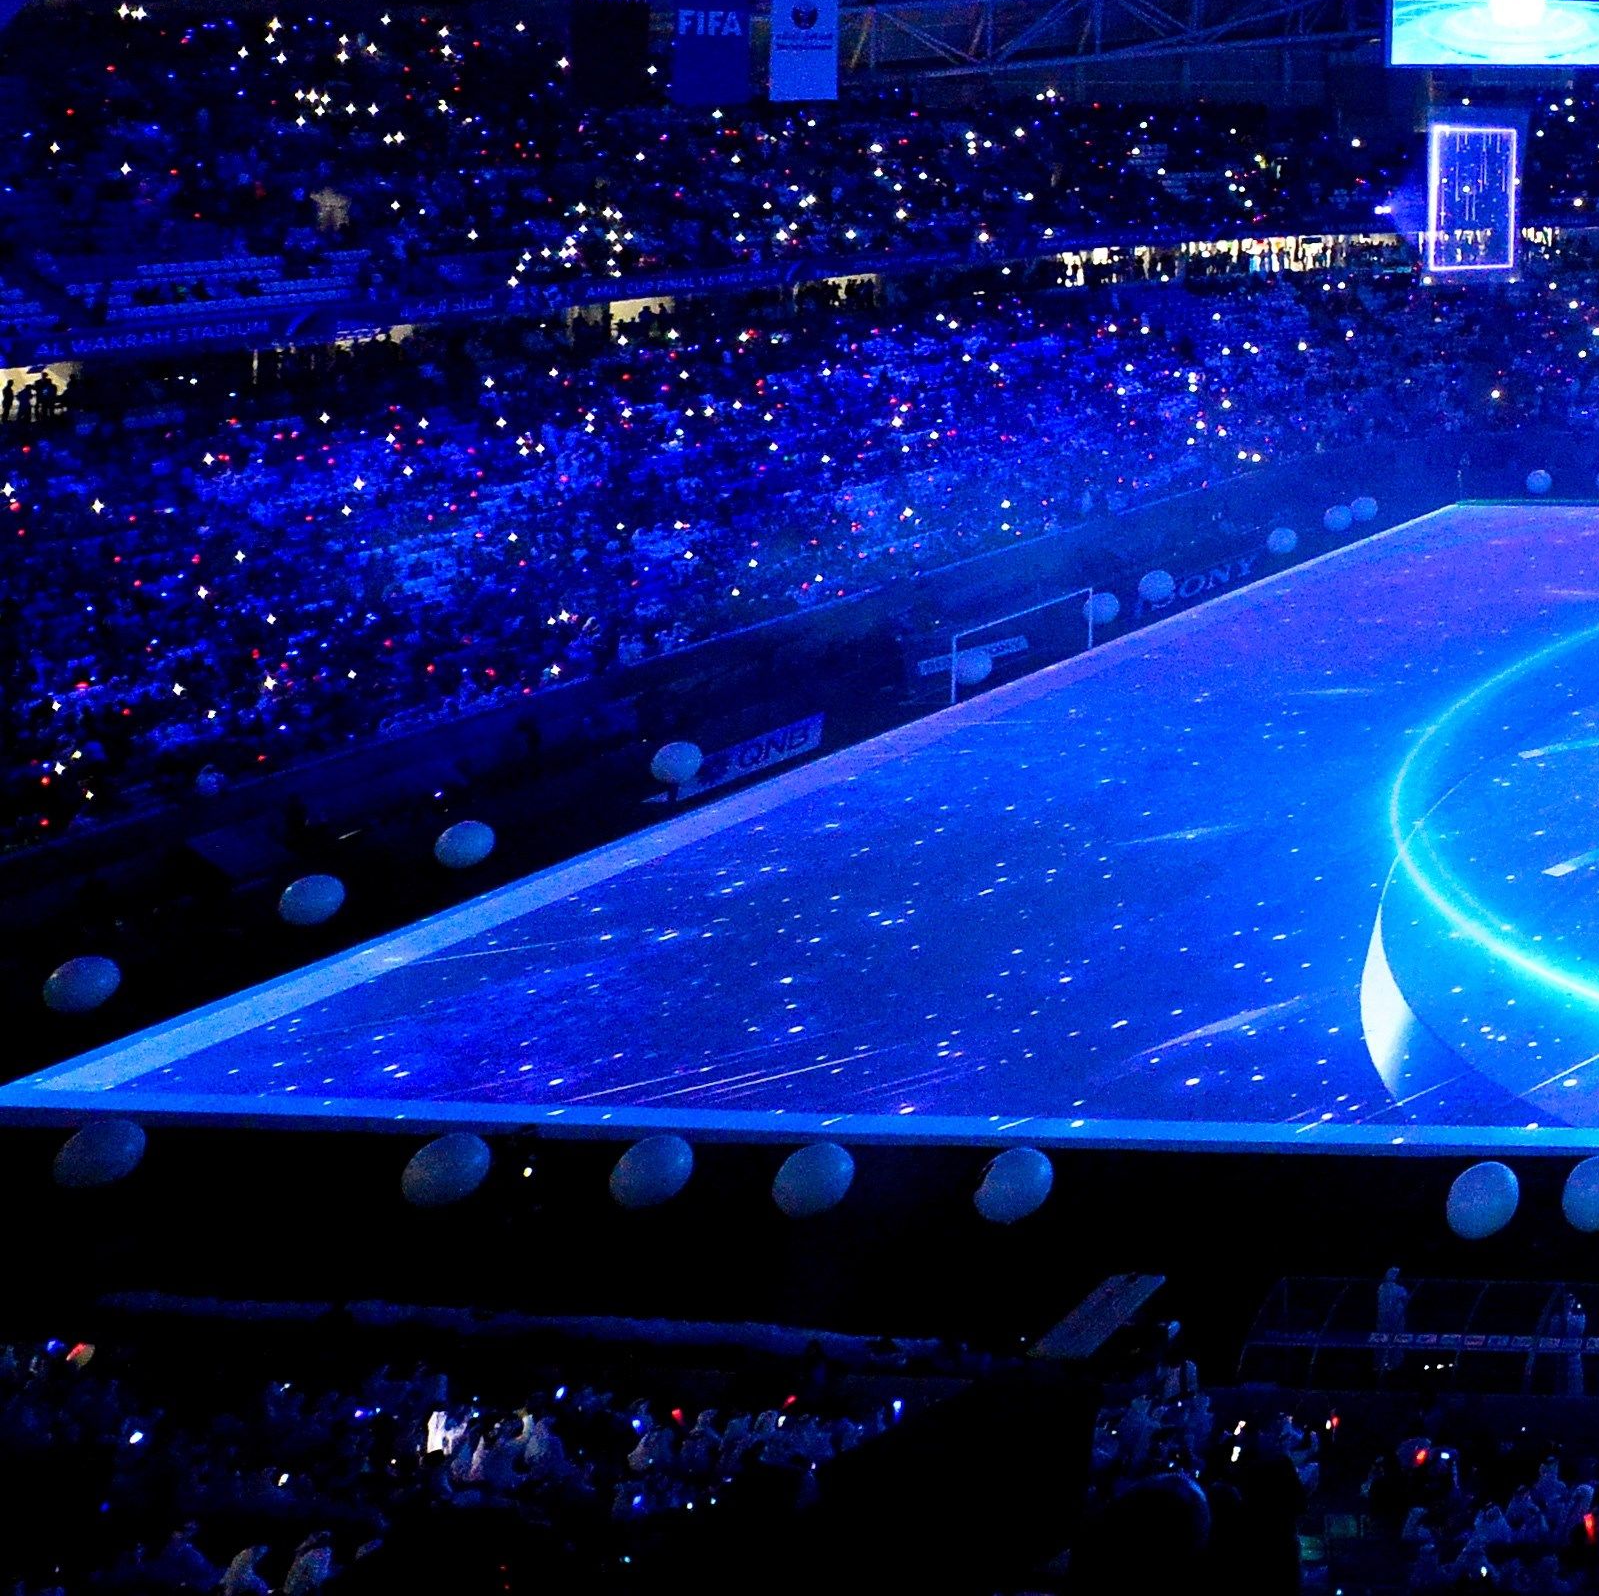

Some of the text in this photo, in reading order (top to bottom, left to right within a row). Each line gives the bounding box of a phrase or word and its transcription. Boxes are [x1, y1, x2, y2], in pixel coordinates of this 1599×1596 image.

[679, 9, 742, 36] FIFA
[34, 320, 269, 357] AL WAKRAH STADIUM
[738, 725, 809, 768] QNB
